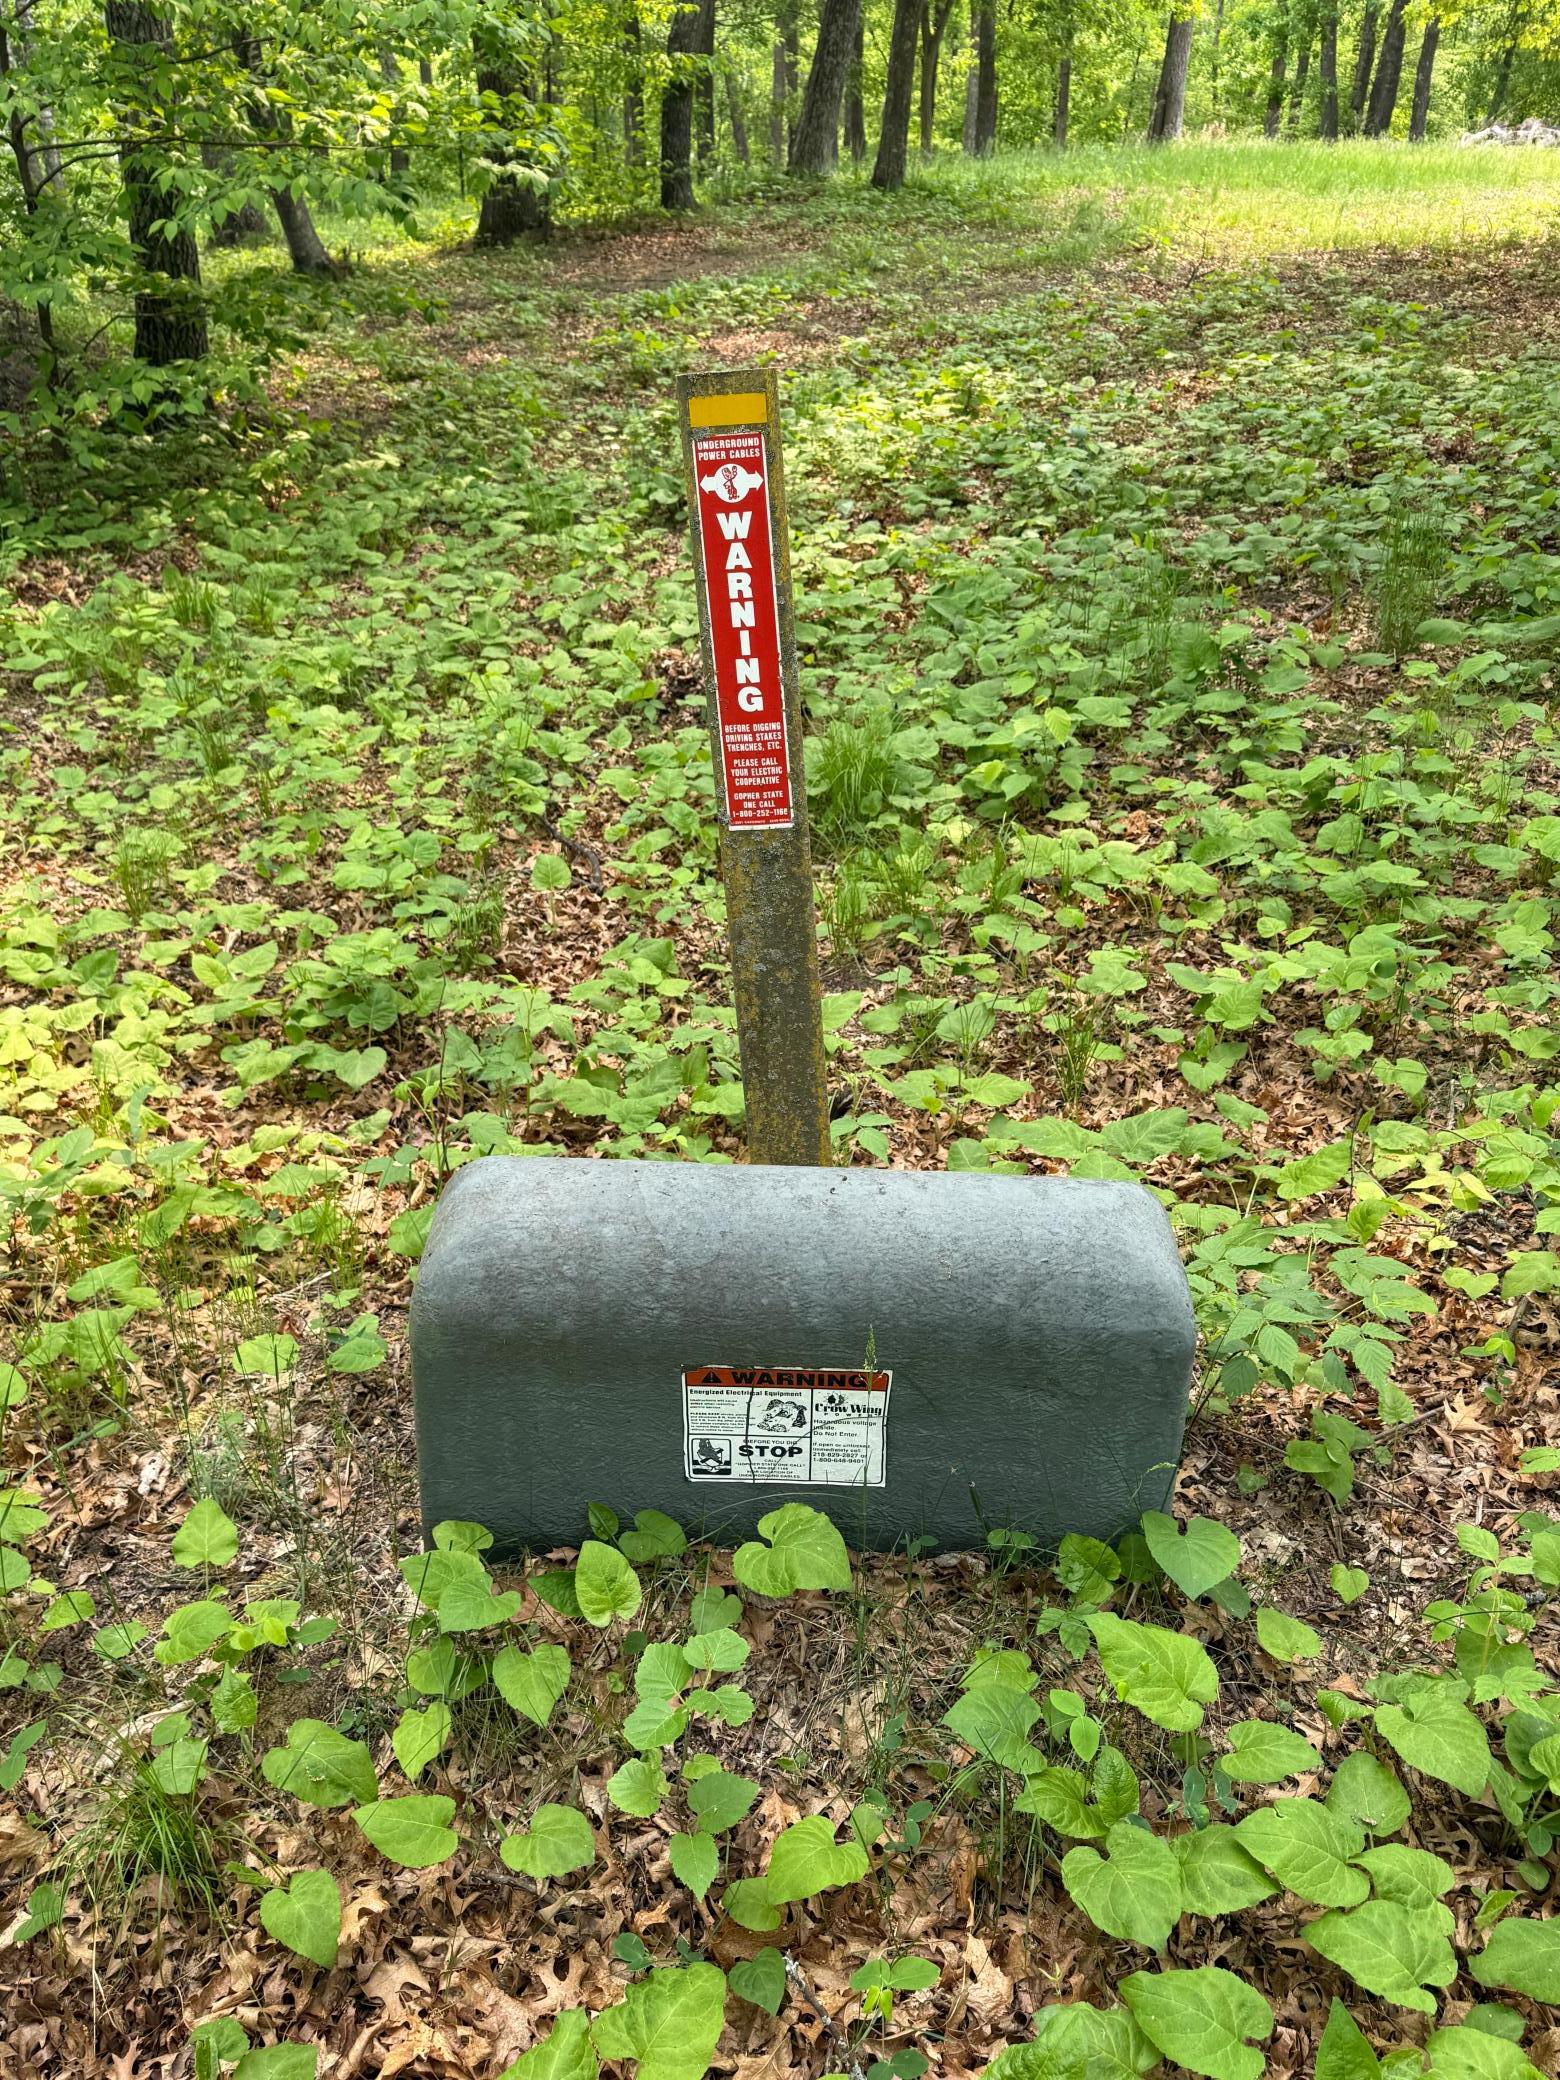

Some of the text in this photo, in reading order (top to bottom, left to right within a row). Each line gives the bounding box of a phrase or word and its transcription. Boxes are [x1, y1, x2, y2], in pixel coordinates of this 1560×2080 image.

[697, 437, 760, 451] UNDERGROUND
[698, 448, 760, 461] POWER CABLES
[715, 510, 764, 713] WARNING
[724, 722, 782, 733] BEFORE DIGGING
[725, 731, 782, 743] DRIVING STAKES
[767, 741, 782, 750] ETC.
[733, 757, 778, 767] PLEASE CALL
[730, 766, 783, 777] YOUR ELECTRIC
[735, 776, 780, 786] COOPERATIVE
[733, 790, 784, 800] GOPHER STATE
[743, 799, 776, 809] ONE CALL
[731, 1371, 868, 1387] WARNING
[689, 1388, 802, 1398] Energized Electrical Equipment
[815, 1403, 882, 1416] Crow Wing
[739, 1445, 803, 1457] STOP
